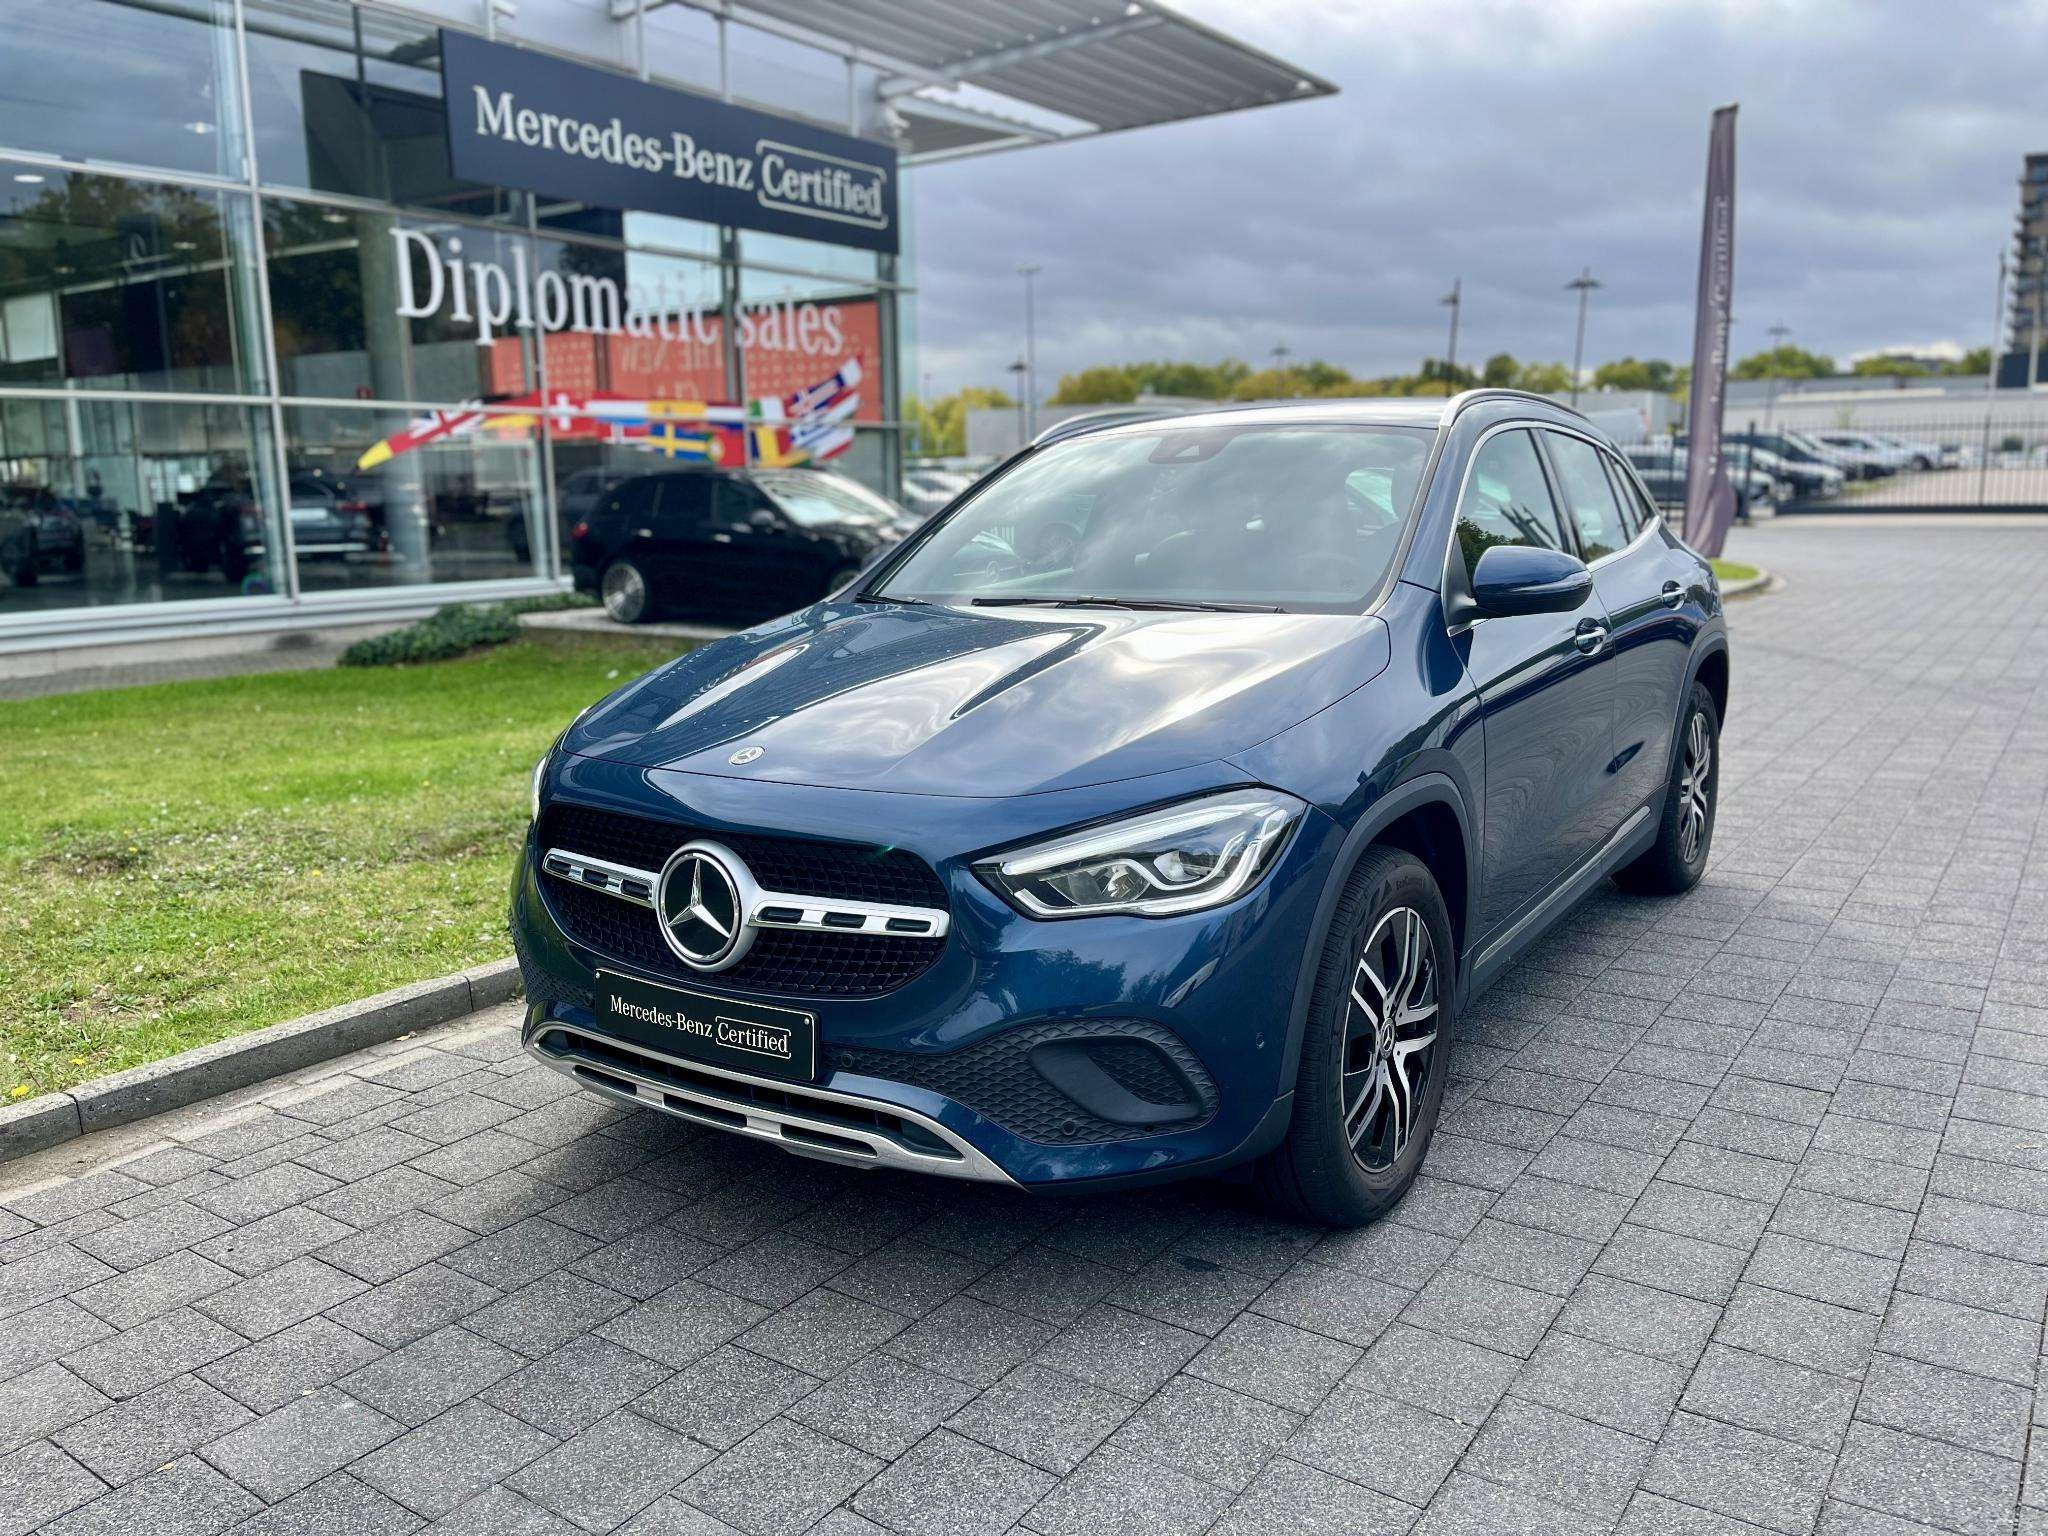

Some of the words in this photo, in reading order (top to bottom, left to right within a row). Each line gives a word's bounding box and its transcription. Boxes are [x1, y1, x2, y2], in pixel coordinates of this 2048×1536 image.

[472, 84, 754, 191] Mercedes-Benz
[761, 153, 884, 218] Certified
[389, 227, 720, 347] Diplomatic
[734, 283, 844, 356] sales
[610, 994, 713, 1037] Mercedes-Benz
[717, 1021, 789, 1054] Certified
